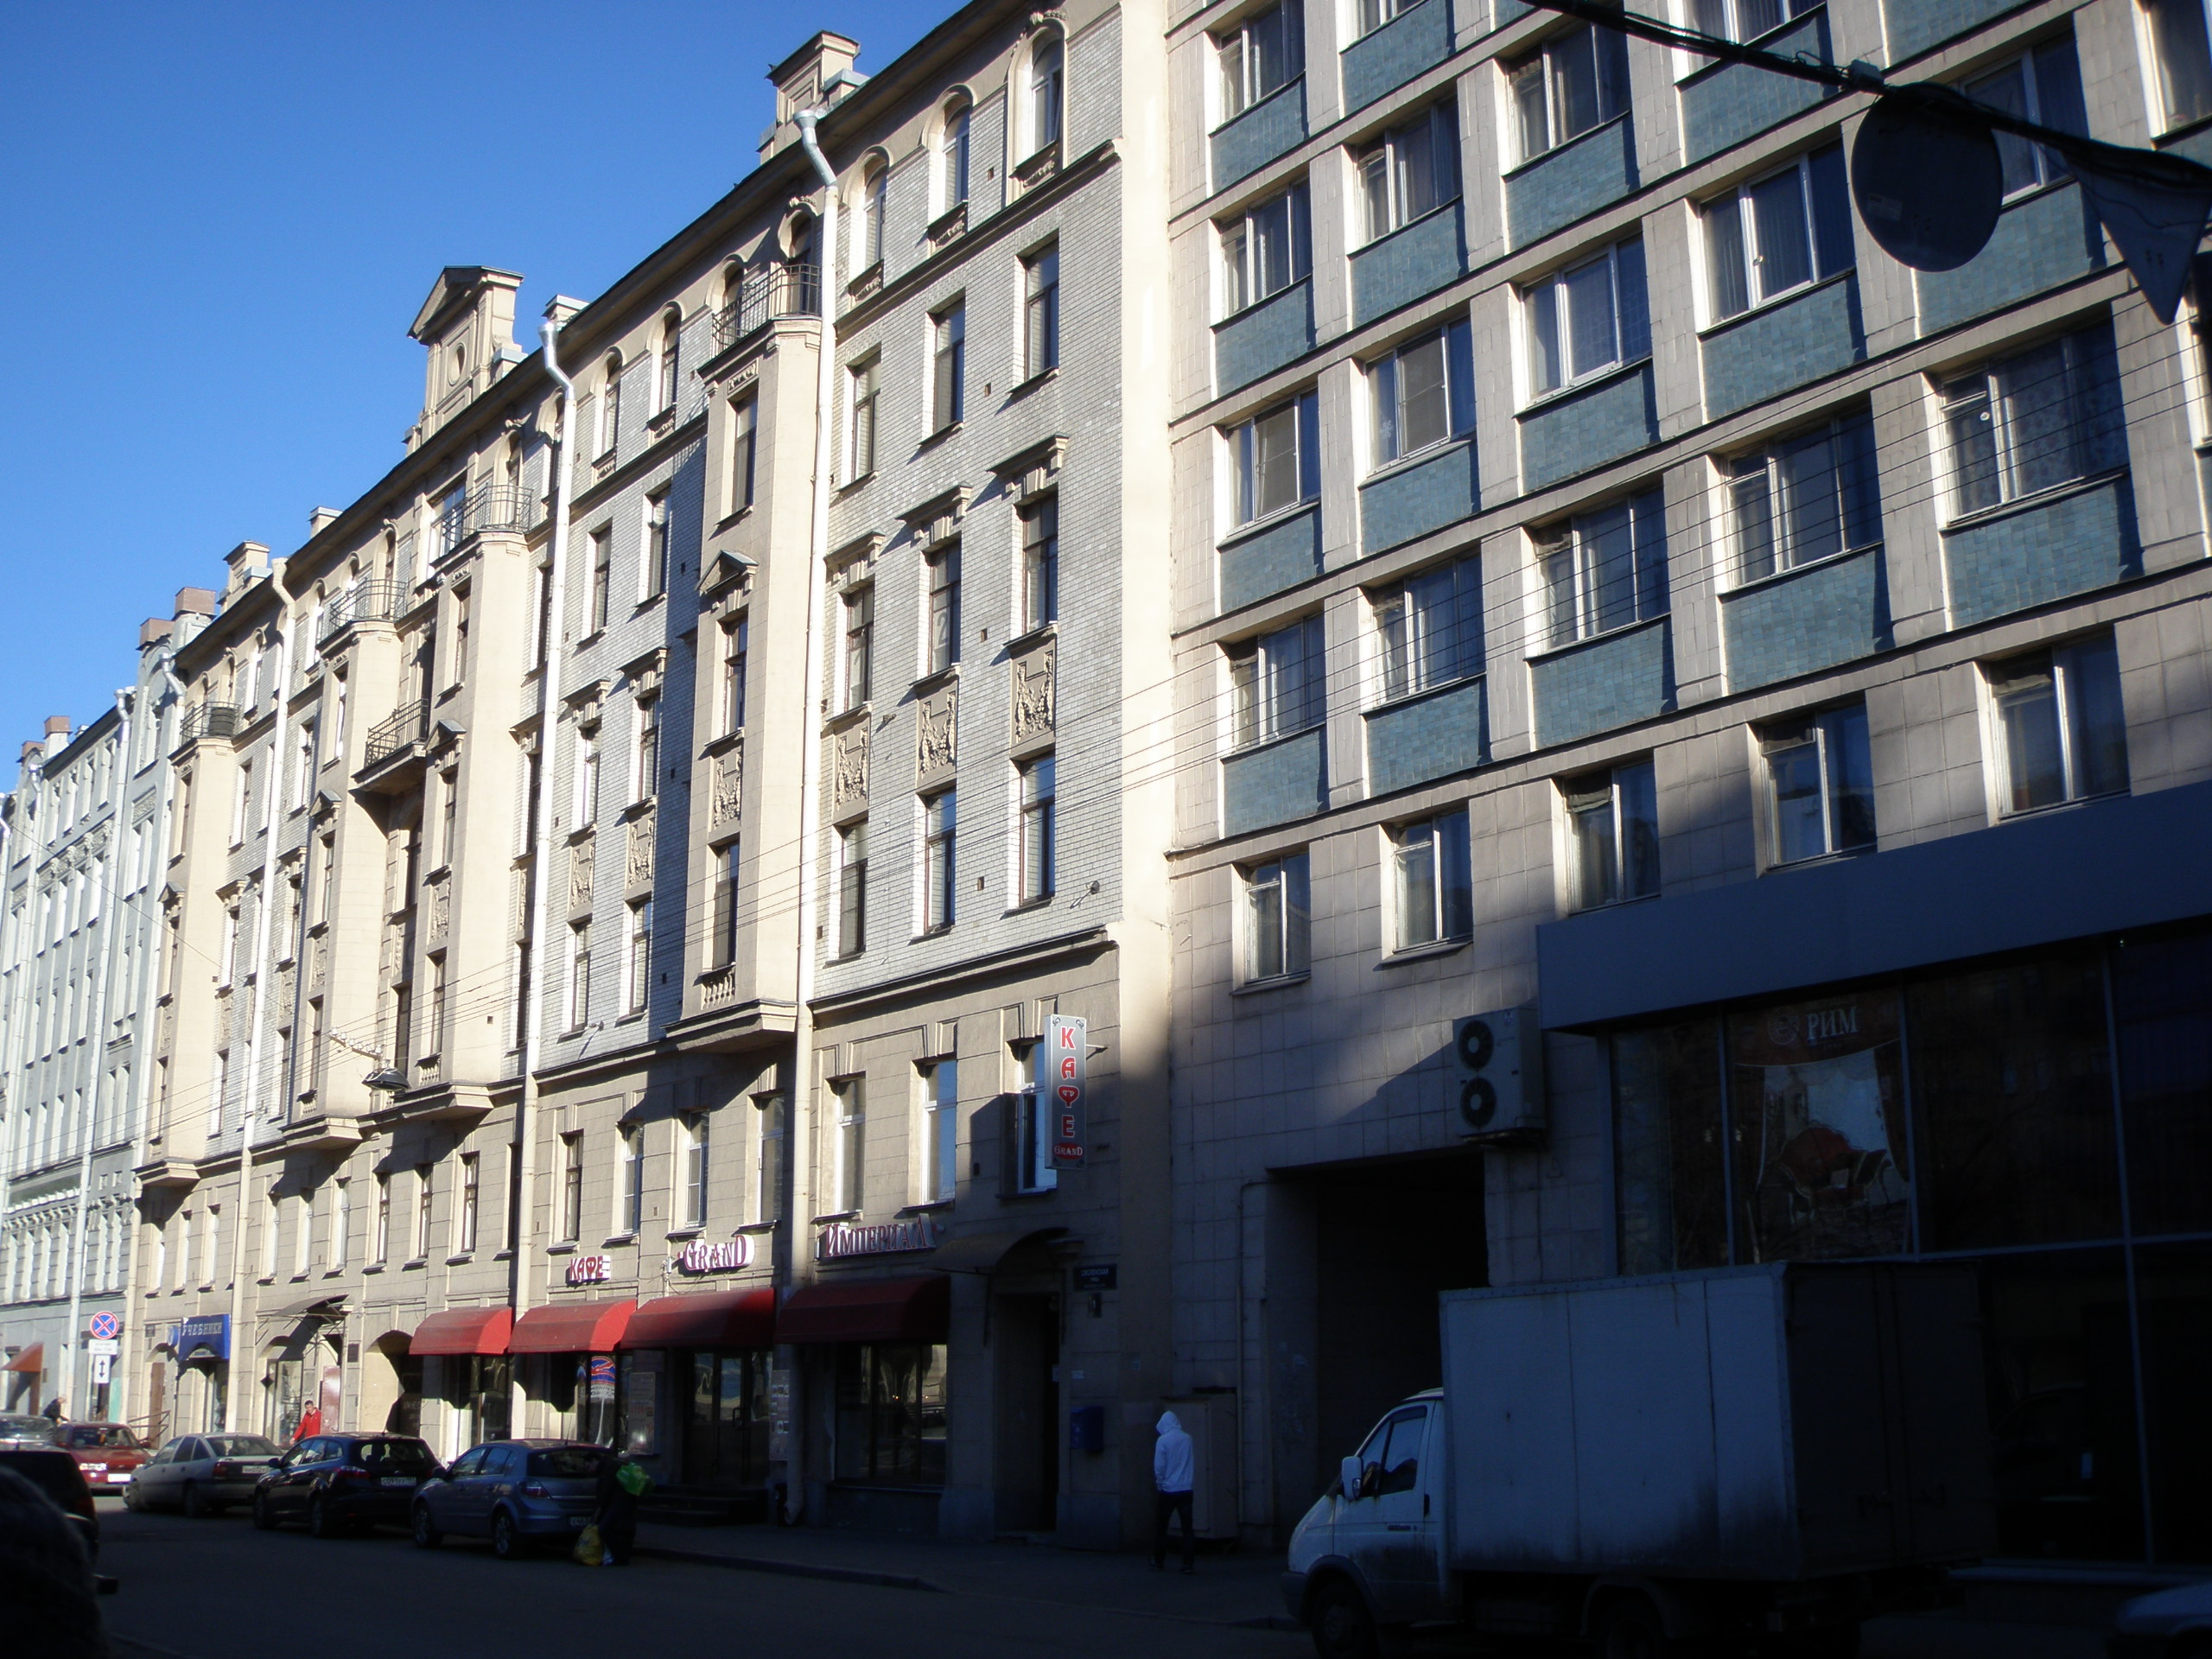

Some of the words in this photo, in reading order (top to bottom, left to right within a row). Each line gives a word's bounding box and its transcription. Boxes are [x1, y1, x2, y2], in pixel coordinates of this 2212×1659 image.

[1805, 1005, 1859, 1041] РИМ
[1058, 1027, 1079, 1138] КАФЕ
[1053, 1145, 1084, 1157] GRAND
[683, 1235, 750, 1271] GRAND
[824, 1214, 931, 1258] ИМПЕРИАЛ
[569, 1255, 606, 1281] КАФЕ
[181, 1322, 223, 1336] УЧЕБНИКИ
